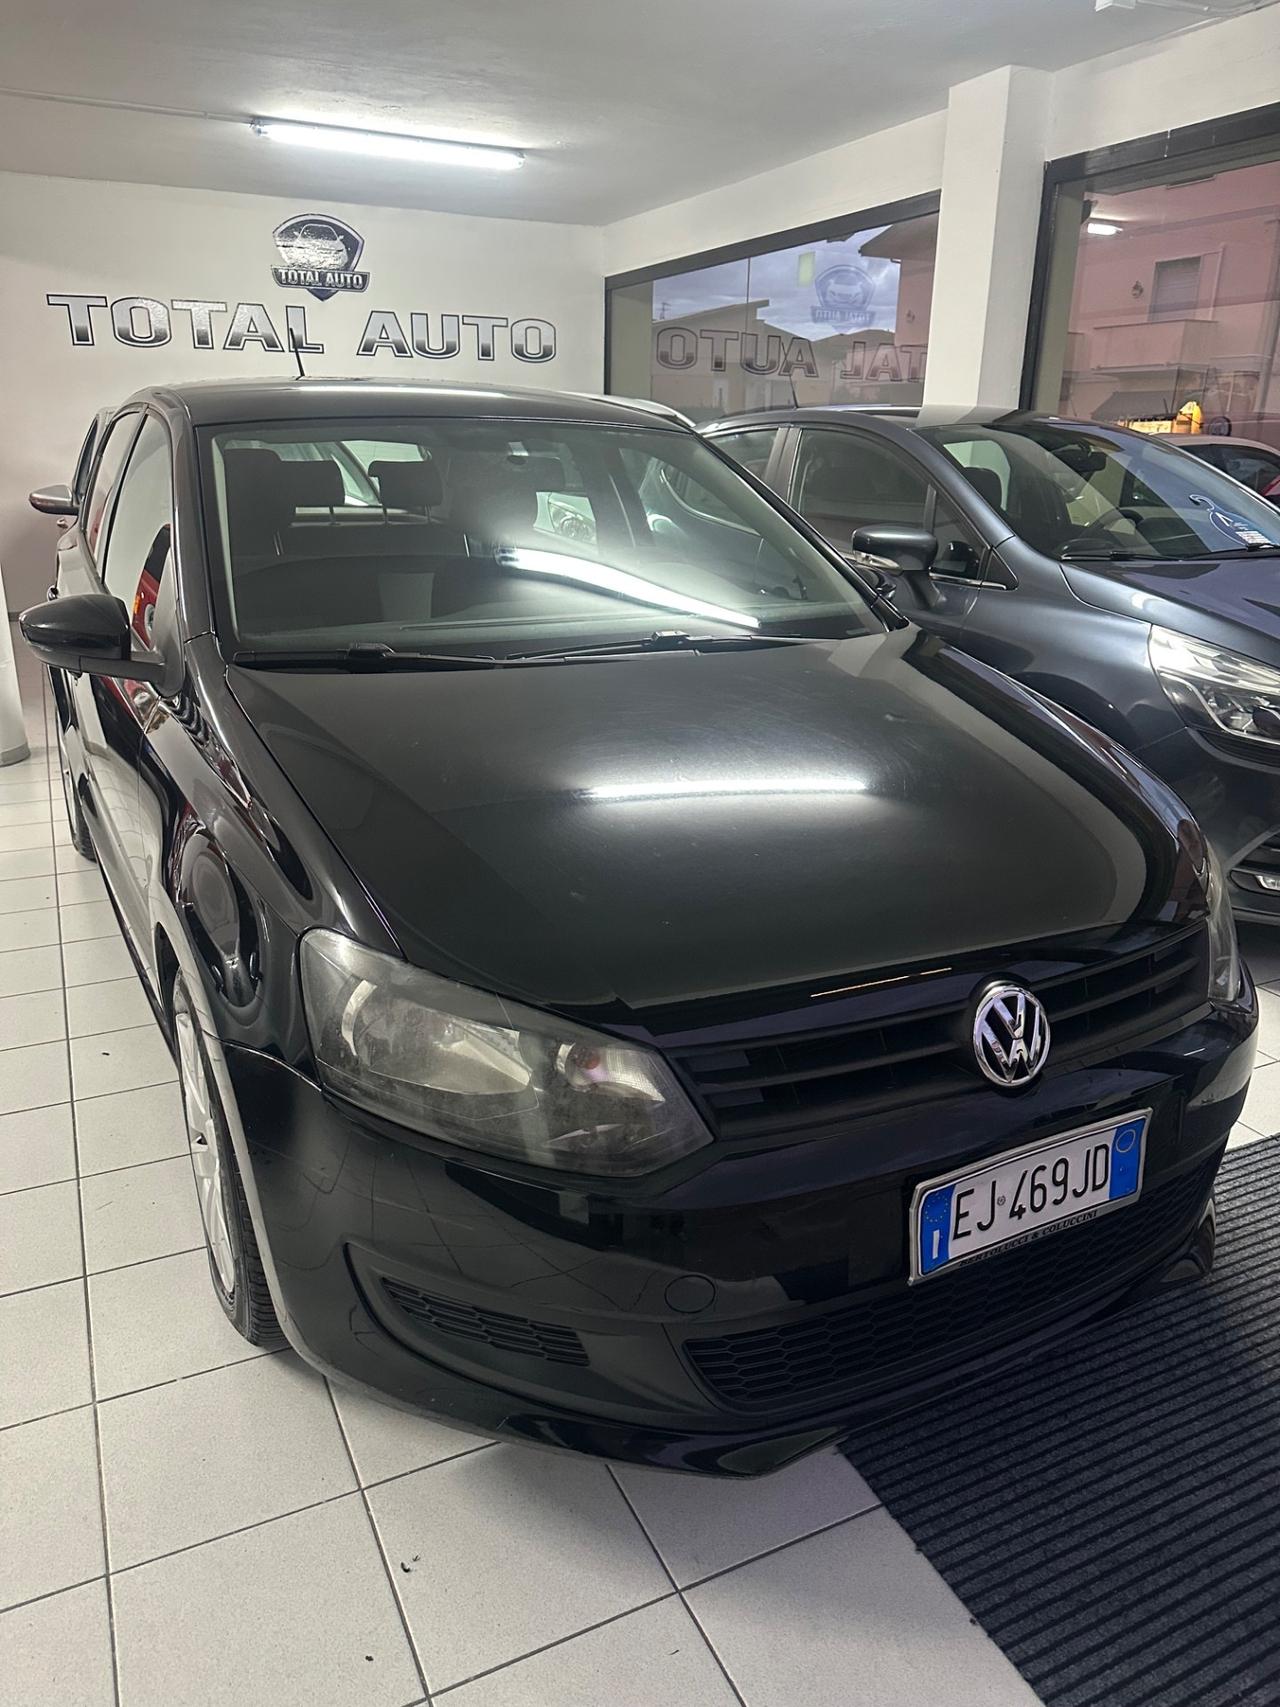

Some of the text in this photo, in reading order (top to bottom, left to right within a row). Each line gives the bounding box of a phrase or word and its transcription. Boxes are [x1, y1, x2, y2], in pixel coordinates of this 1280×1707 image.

[279, 269, 363, 288] TOTAL AUTO
[46, 294, 556, 363] TOTAL AUTO
